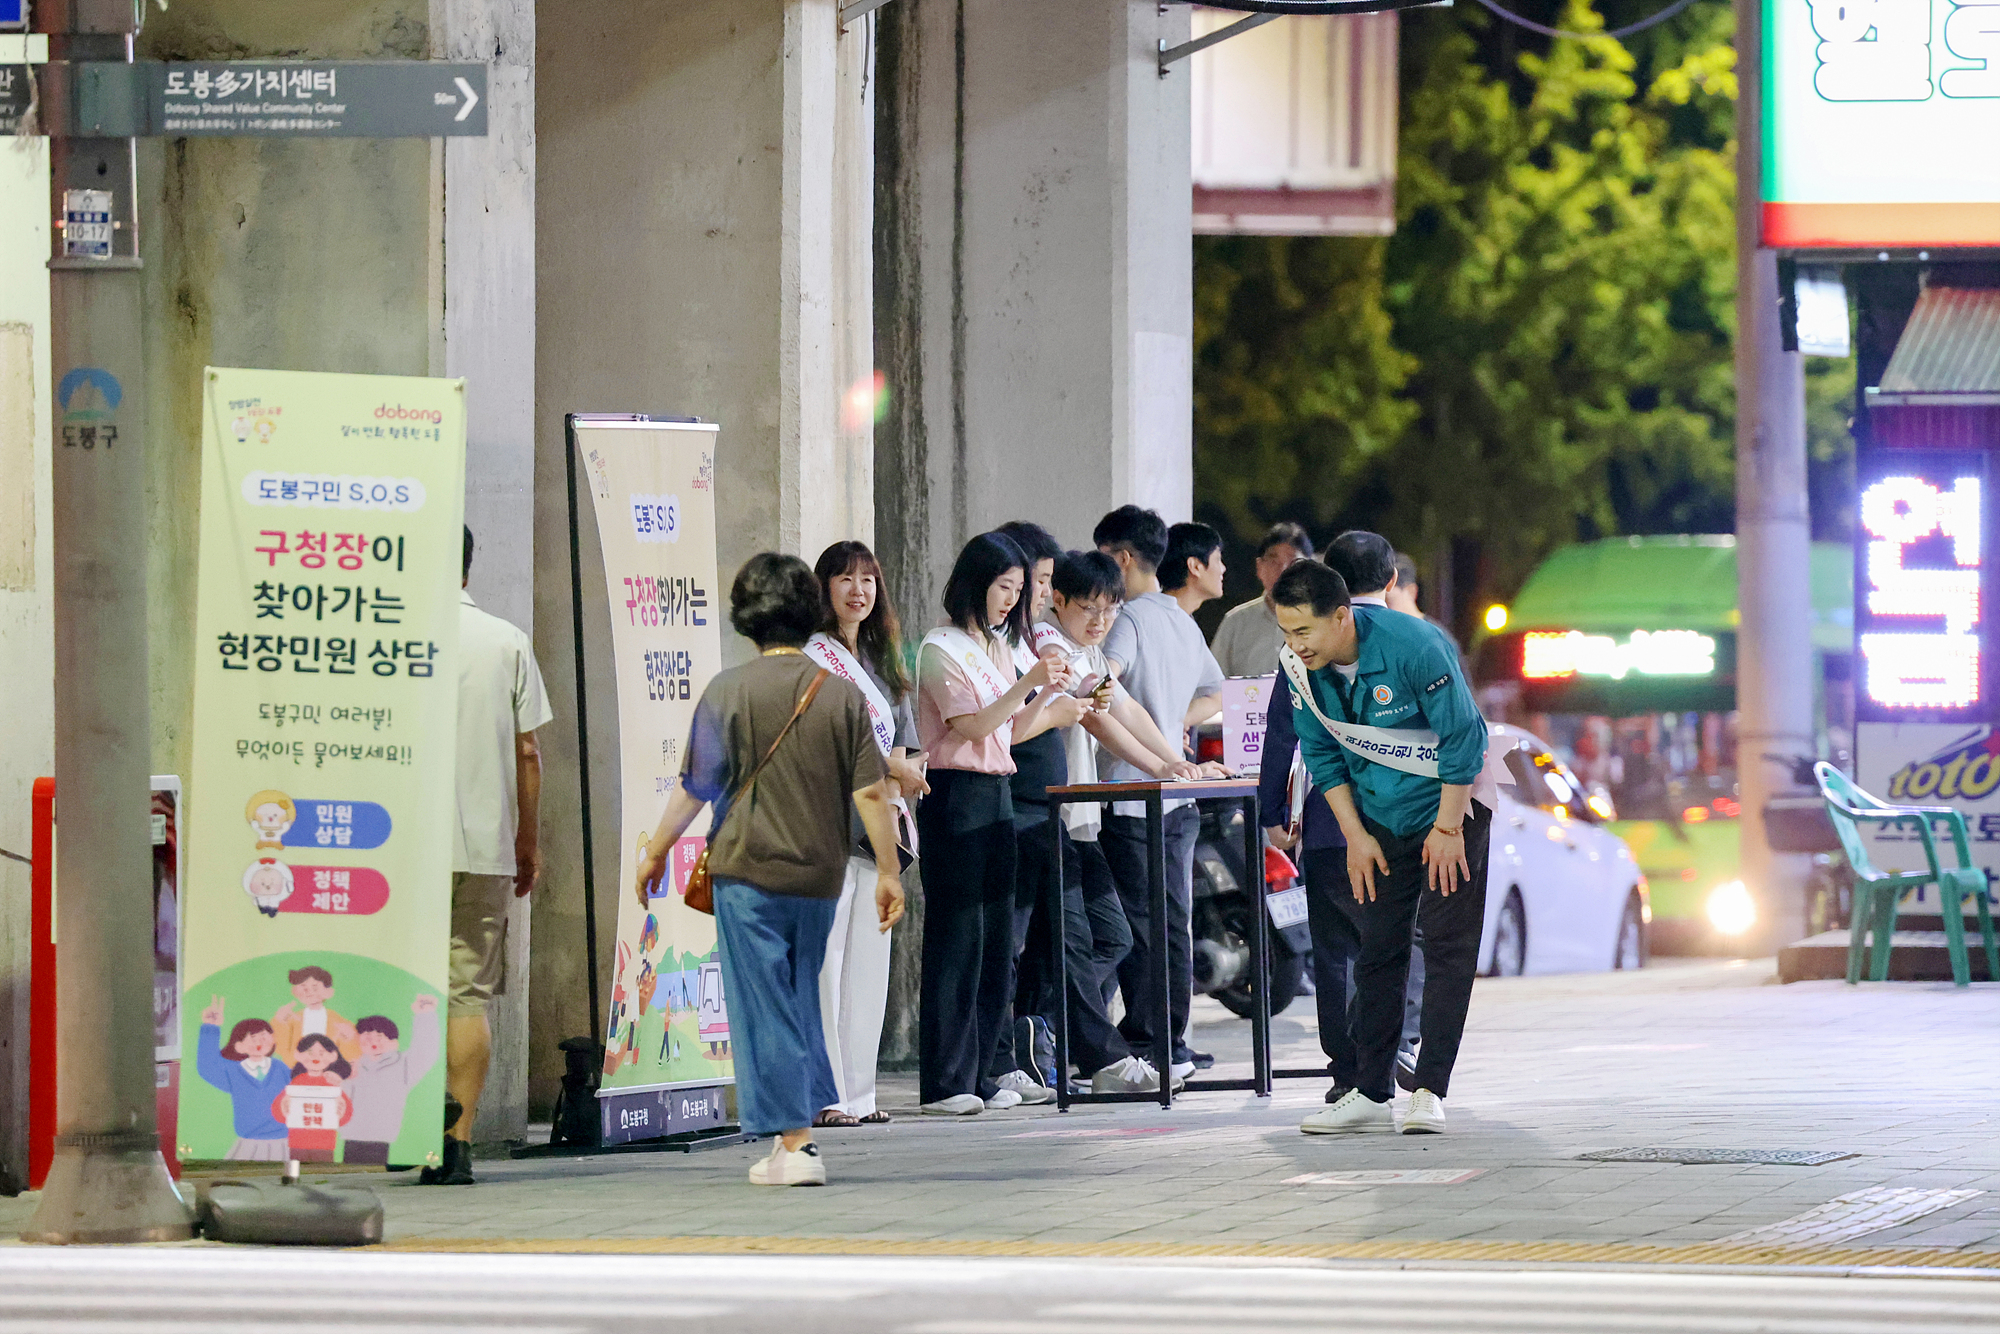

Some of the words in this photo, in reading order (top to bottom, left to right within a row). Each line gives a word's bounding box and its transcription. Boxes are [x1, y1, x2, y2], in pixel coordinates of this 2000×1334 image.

[164, 69, 336, 99] 도봉多가치센터
[164, 102, 200, 116] Dobong
[202, 102, 233, 113] Shared
[235, 102, 260, 113] Value
[262, 102, 312, 115] Community
[315, 102, 346, 113] Center
[71, 225, 106, 239] 10-17
[374, 403, 442, 424] dobong
[62, 425, 118, 449] 도봉구
[259, 479, 341, 502] 도봉구민
[254, 530, 405, 571] 구청장이
[253, 580, 405, 624] 찾아가는
[217, 631, 356, 674] 현장민원
[367, 639, 439, 677] 상담
[259, 703, 321, 727] 도봉구민
[330, 706, 392, 731] 여러분!
[236, 739, 304, 765] 무엇이든
[314, 742, 412, 768] 물어보세요!!
[1344, 735, 1413, 759] 현장민원
[316, 804, 353, 824] 민원
[315, 825, 353, 845] 상담
[312, 870, 351, 890] 정책
[312, 892, 351, 911] 제안
[629, 1107, 649, 1128] 도봉구청
[690, 1098, 709, 1118] 도봉구청
